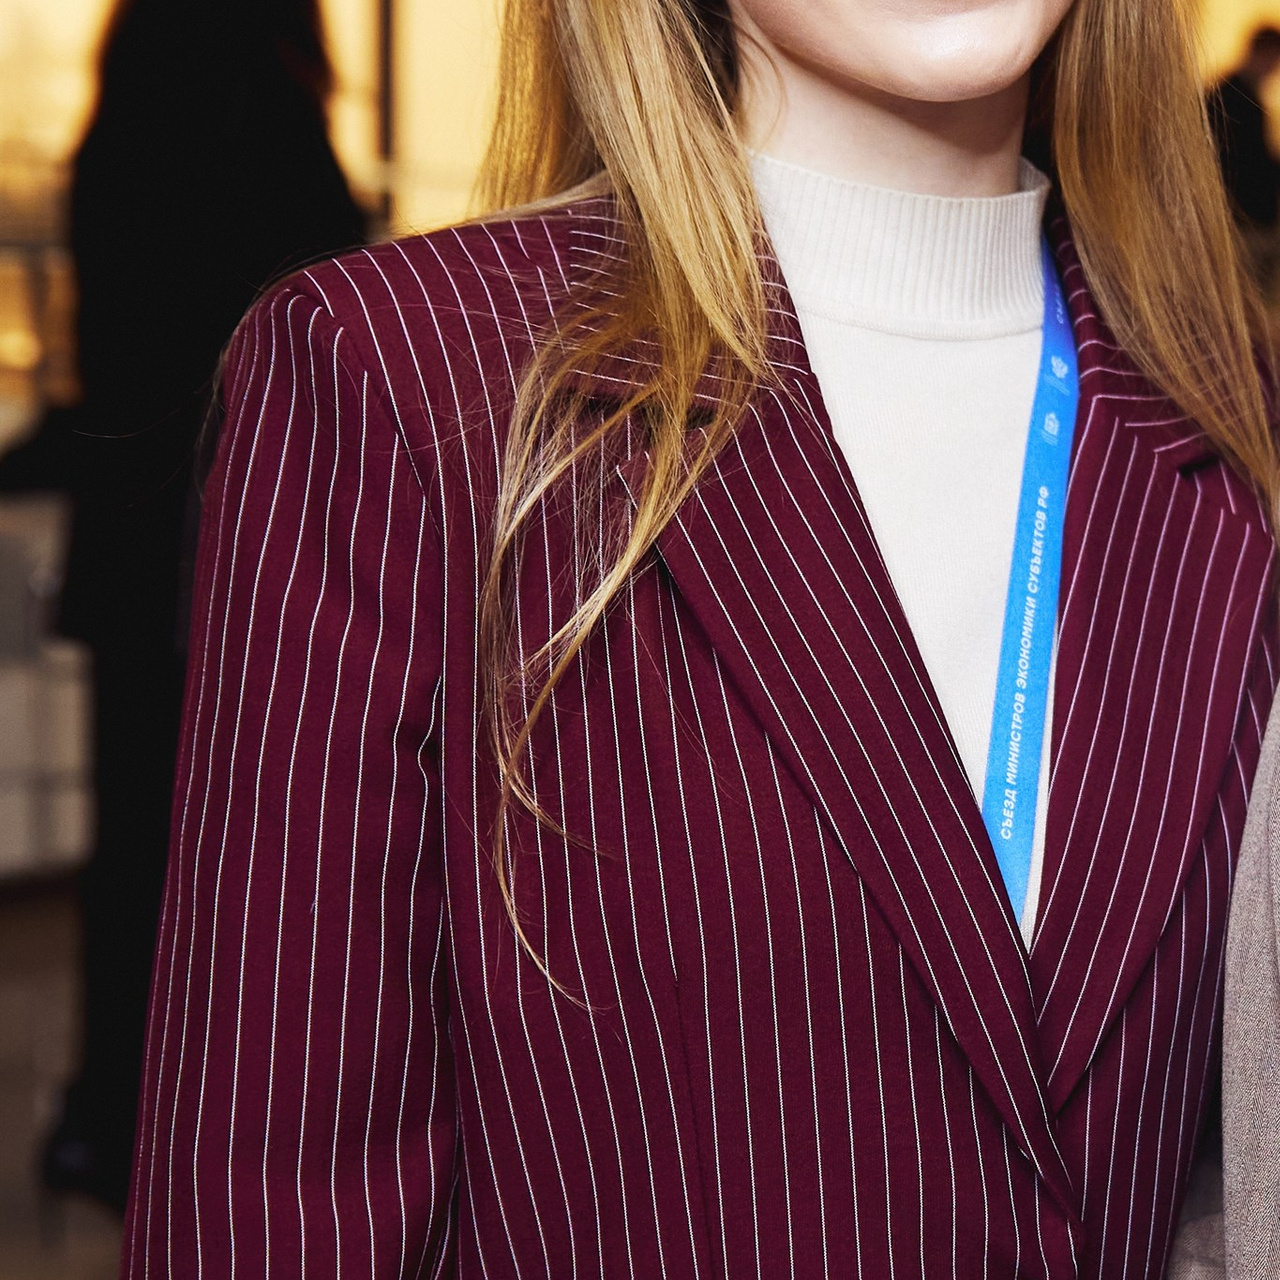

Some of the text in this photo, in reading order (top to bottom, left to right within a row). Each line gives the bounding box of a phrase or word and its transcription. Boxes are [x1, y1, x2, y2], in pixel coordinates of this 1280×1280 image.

[1001, 485, 1050, 840] СЪЕЗД МИНИСТРОВ ЭКОНОМИКИ СУБЪЕКТОВ РФ
